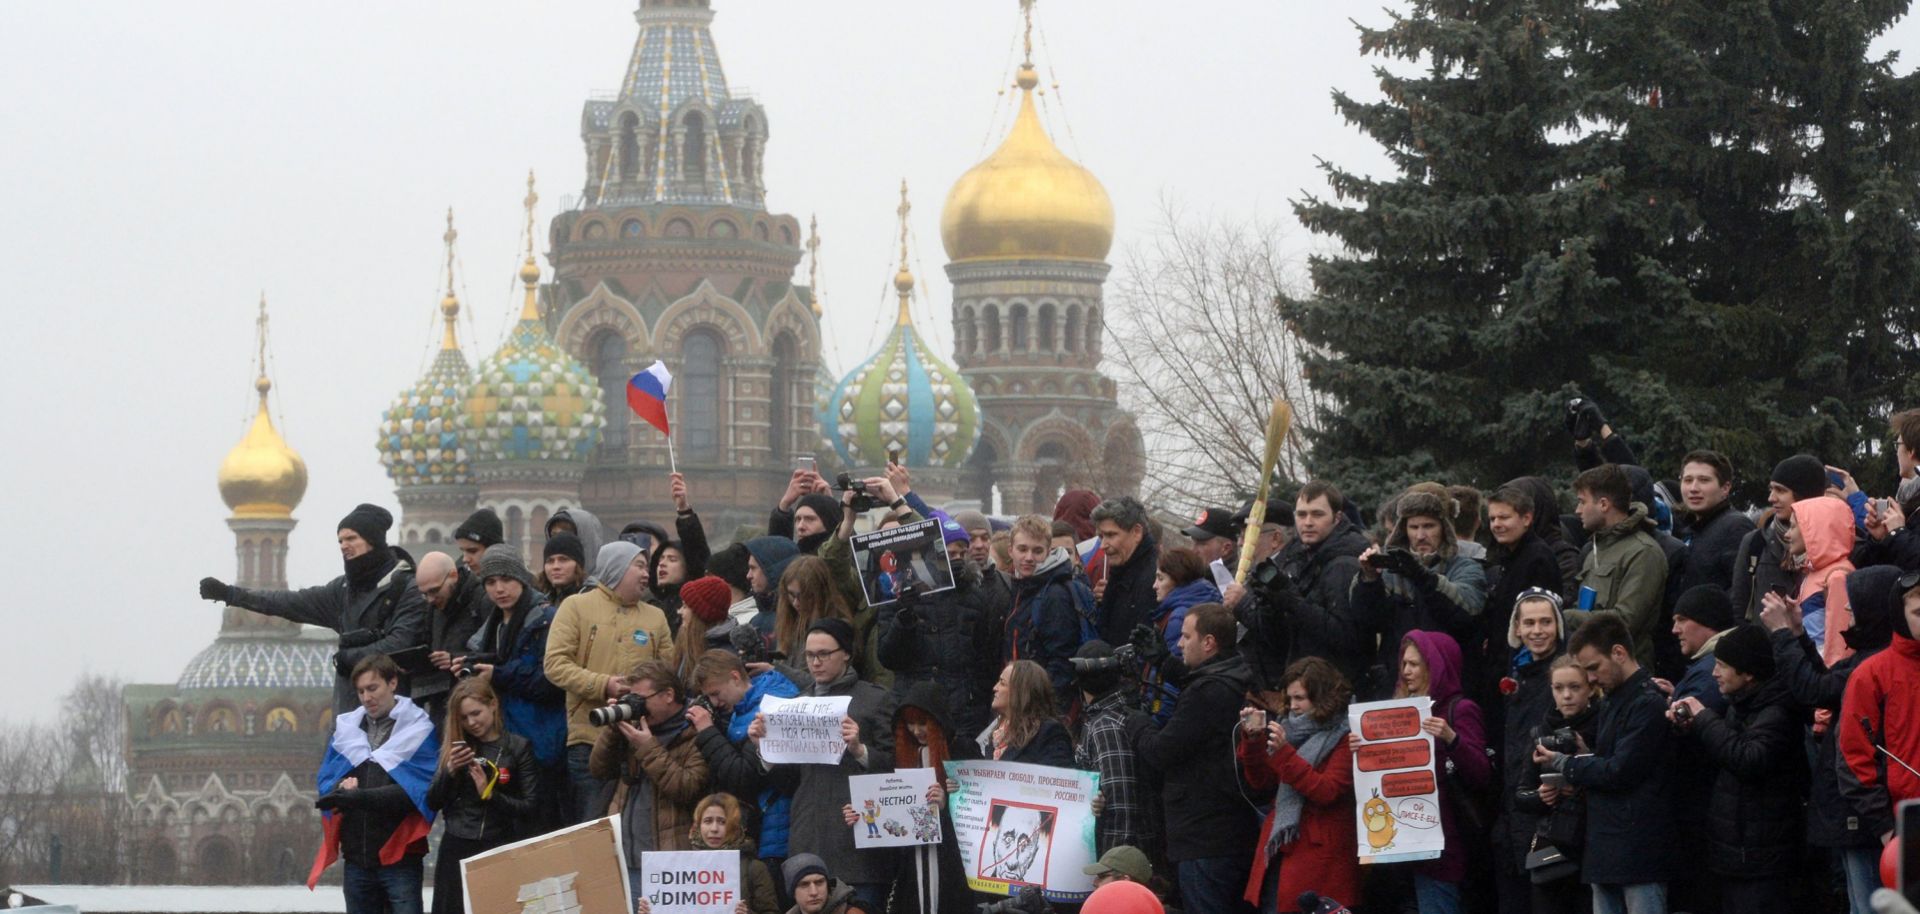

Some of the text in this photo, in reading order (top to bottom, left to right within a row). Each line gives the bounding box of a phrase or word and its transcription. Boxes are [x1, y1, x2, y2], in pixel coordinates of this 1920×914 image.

[806, 715, 817, 727] НА
[781, 727, 831, 740] МОЯ СТРАНА
[763, 740, 818, 753] ПРЕВРАТИЛАСЬ
[821, 741, 827, 753] В
[956, 768, 1081, 789] МЫ ВЫБИРАЕМ СВОБОДУ, ПРОСВЕЩЕНИЕ,
[879, 794, 917, 807] ЧЕСТНО!
[1054, 791, 1078, 802] РОССИЮ
[1413, 803, 1424, 812] ОЙ
[662, 870, 725, 885] DIMON
[662, 891, 733, 905] DIMOFF
